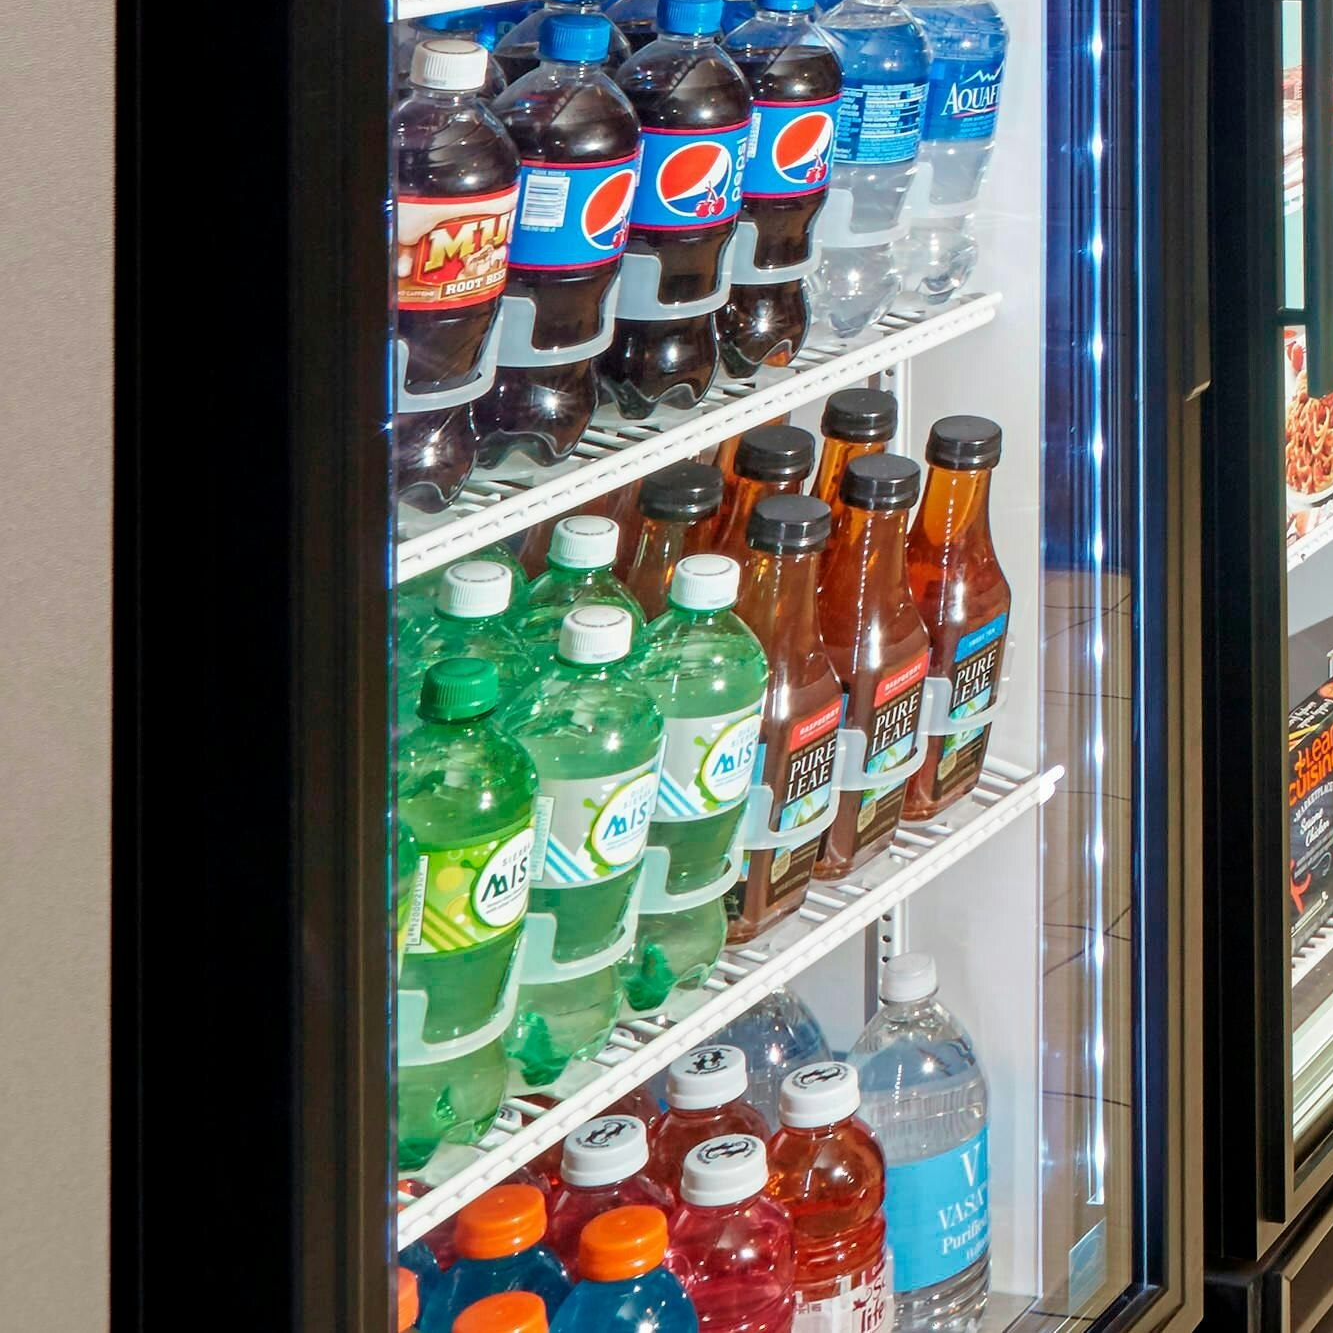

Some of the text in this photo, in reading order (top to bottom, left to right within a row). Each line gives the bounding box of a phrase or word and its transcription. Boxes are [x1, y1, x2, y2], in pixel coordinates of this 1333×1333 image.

[445, 276, 483, 296] ROOT
[952, 670, 992, 709] LEAF
[955, 649, 997, 692] PURE
[870, 713, 913, 757] LEAF
[873, 691, 920, 737] PURE
[788, 737, 835, 784] PURE
[785, 761, 830, 804] LEAF
